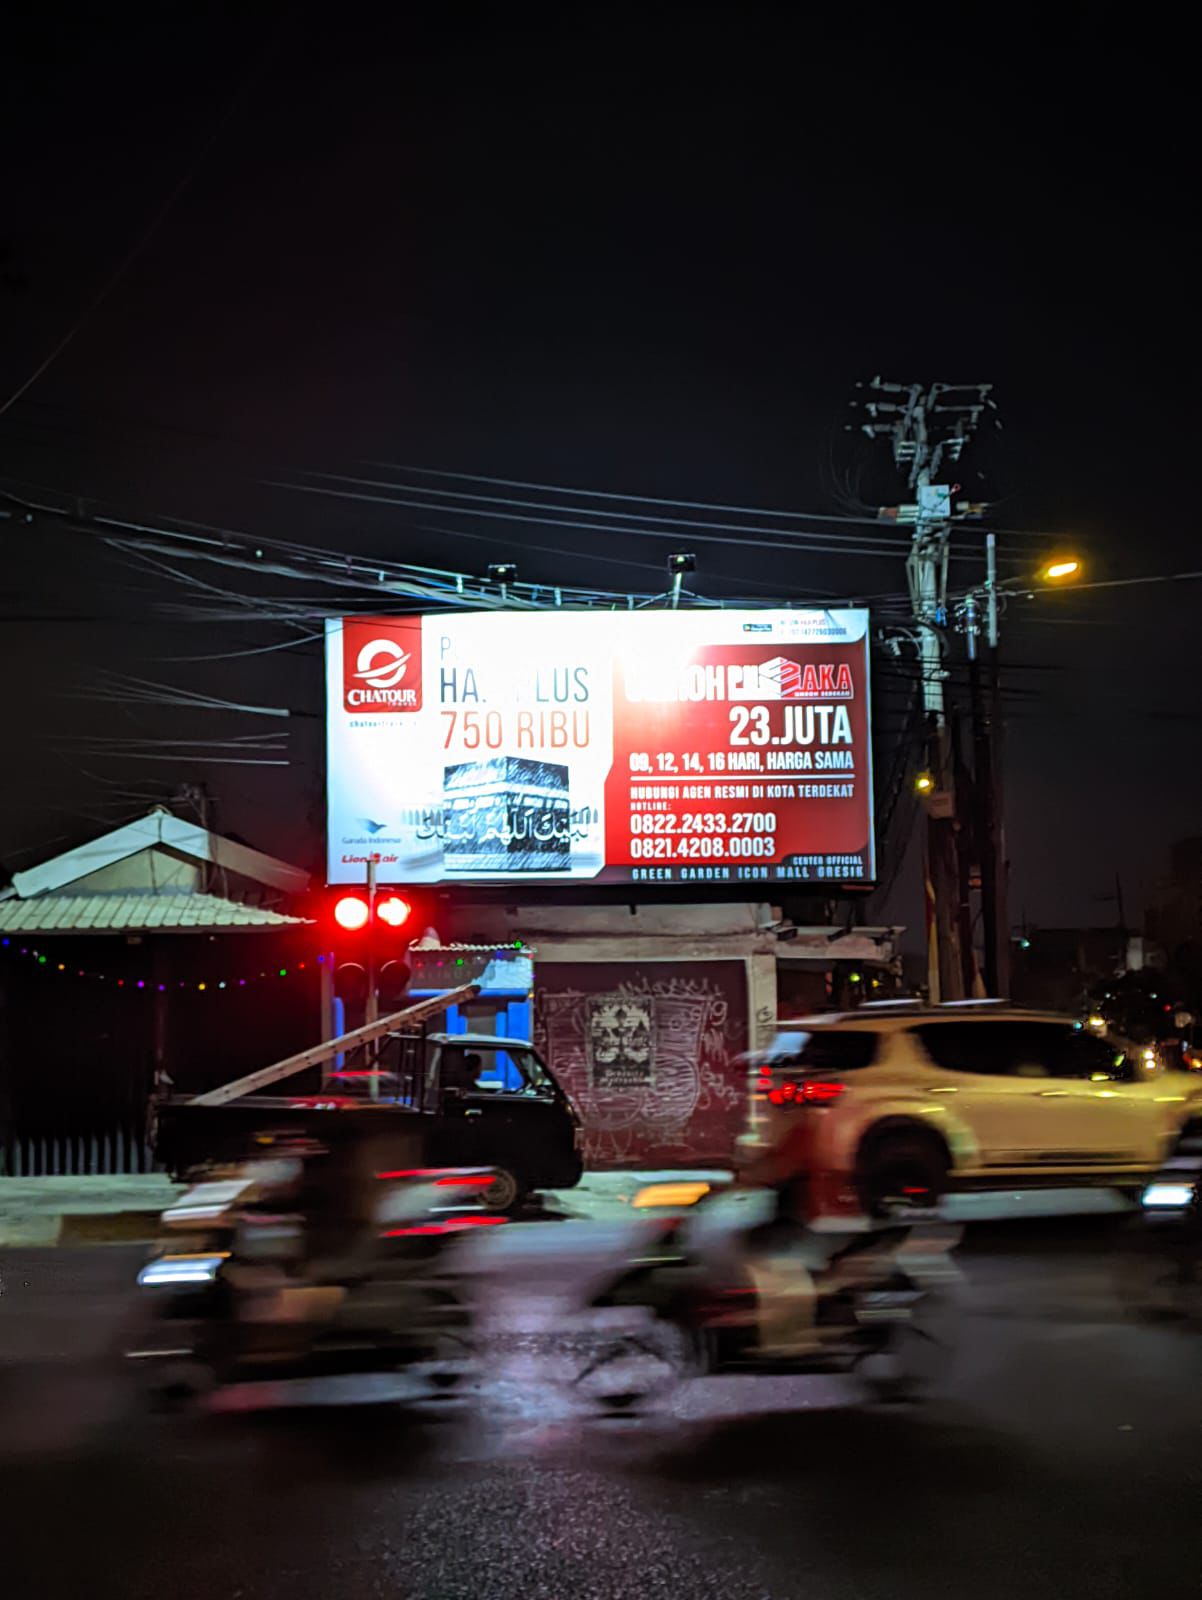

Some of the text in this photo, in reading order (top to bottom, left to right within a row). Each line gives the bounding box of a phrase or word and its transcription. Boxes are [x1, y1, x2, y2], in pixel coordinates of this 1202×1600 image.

[347, 688, 417, 706] CHATOUR
[440, 710, 590, 749] 750 RIBU
[729, 705, 853, 746] 23.JUTA
[656, 752, 679, 773] 12,
[682, 752, 704, 773] 14,
[707, 752, 726, 771] 16
[727, 752, 764, 772] HARI,
[766, 751, 813, 770] HARGA
[814, 750, 855, 769] SAMA
[682, 785, 712, 799] AGEN
[714, 785, 749, 799] RESMI
[752, 784, 764, 798] DI
[767, 784, 795, 798] KOTA
[798, 783, 855, 798] TERDEKAT
[630, 813, 777, 834] 0822.2433.2700
[630, 836, 776, 858] 0821.4208.0003
[382, 854, 399, 863] air
[632, 866, 864, 880] GREEN GARDEN ICON MALL GRESIK
